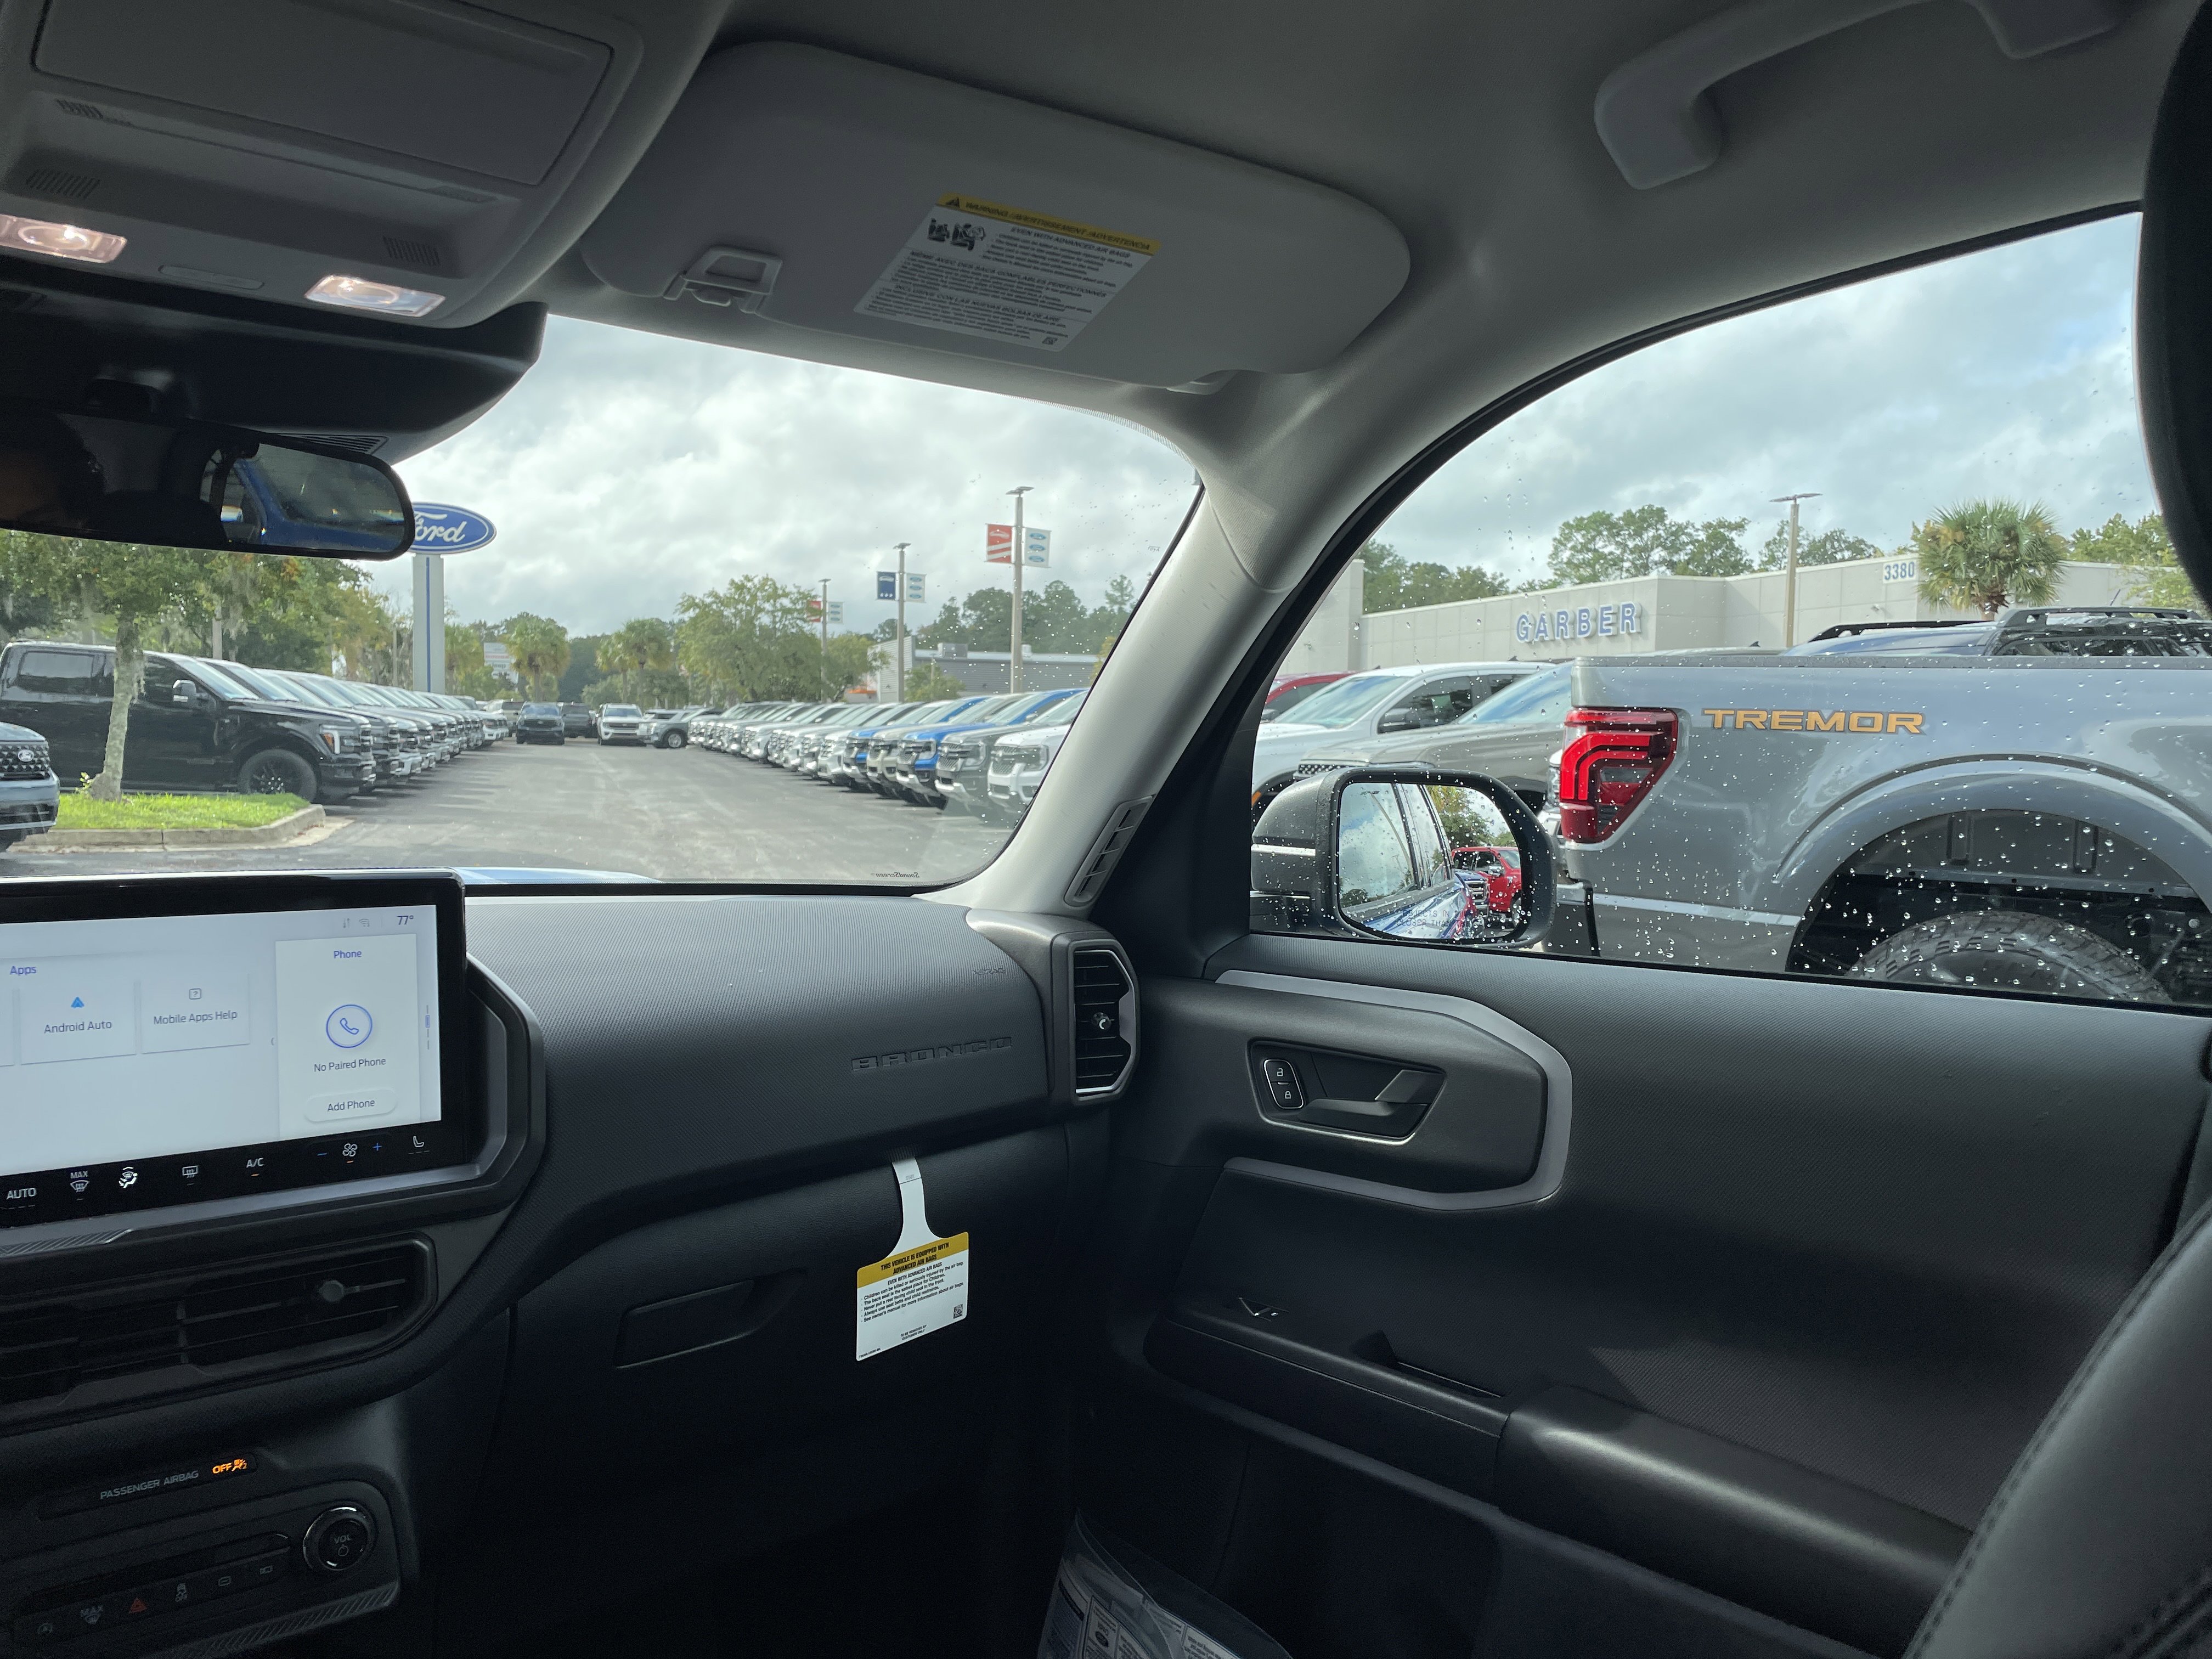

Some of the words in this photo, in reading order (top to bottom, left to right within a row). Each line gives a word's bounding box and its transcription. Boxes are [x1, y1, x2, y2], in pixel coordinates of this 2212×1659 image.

[1884, 561, 1915, 580] 3380
[1516, 601, 1636, 642] GARBER
[1703, 708, 1924, 734] TREMOR
[397, 915, 414, 926] 77°
[333, 950, 362, 959] Phone
[9, 966, 37, 975] Apps
[153, 1014, 187, 1025] Mobile
[189, 1012, 213, 1023] Apps
[215, 1011, 238, 1021] Help
[44, 1022, 85, 1034] Android
[87, 1020, 112, 1030] Auto
[851, 1036, 1012, 1071] BRONCO
[314, 1063, 326, 1072] No
[329, 1059, 356, 1070] Paired
[358, 1058, 386, 1068] Phone
[328, 1102, 345, 1111] Add
[347, 1099, 375, 1110] Phone
[246, 1158, 264, 1168] A/C
[70, 1170, 88, 1179] MAX
[6, 1187, 37, 1200] AUTO
[881, 1262, 890, 1271] THIS
[892, 1255, 910, 1267] VEHICLE
[916, 1246, 936, 1259] EQUIPPED
[938, 1242, 949, 1251] WITH
[893, 1261, 916, 1274] ADVANCED
[926, 1254, 936, 1263] BAGS
[908, 1268, 925, 1278] ADVANCED
[212, 1462, 233, 1474] OFF
[100, 1479, 160, 1499] PASSENGER
[163, 1470, 199, 1485] AIRBAG
[334, 1534, 352, 1544] VOL
